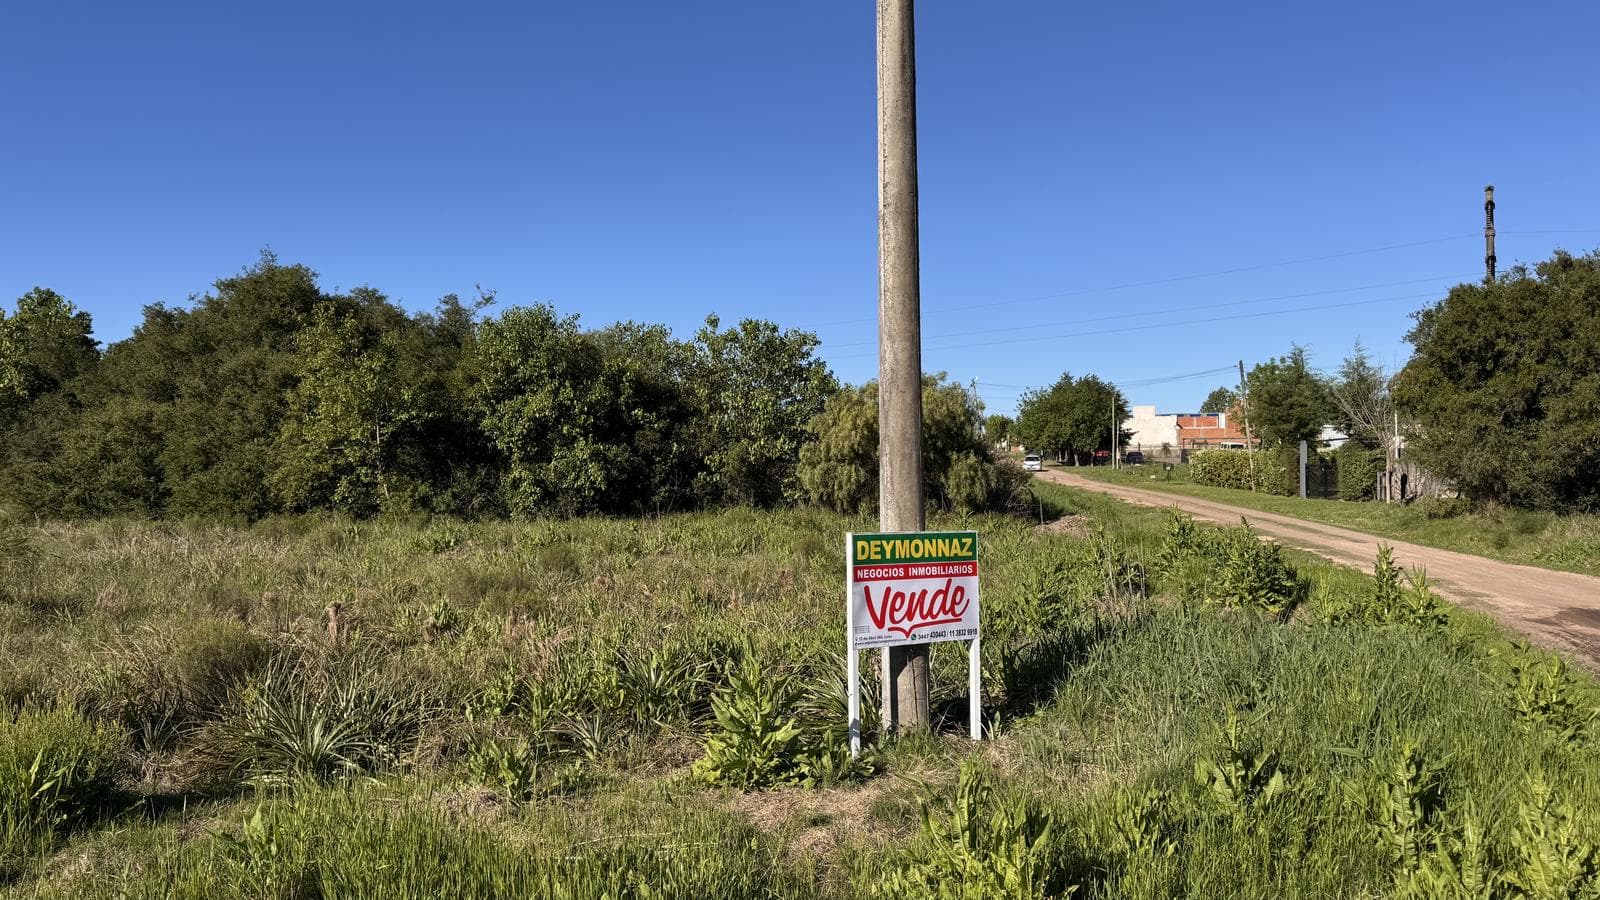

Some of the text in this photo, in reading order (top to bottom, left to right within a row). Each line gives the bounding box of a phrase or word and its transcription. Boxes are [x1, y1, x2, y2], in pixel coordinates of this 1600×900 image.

[857, 538, 973, 560] DEYMONNAZ
[857, 565, 973, 579] NEGOCIOS INMOBILIARIOS
[864, 578, 970, 629] Vende
